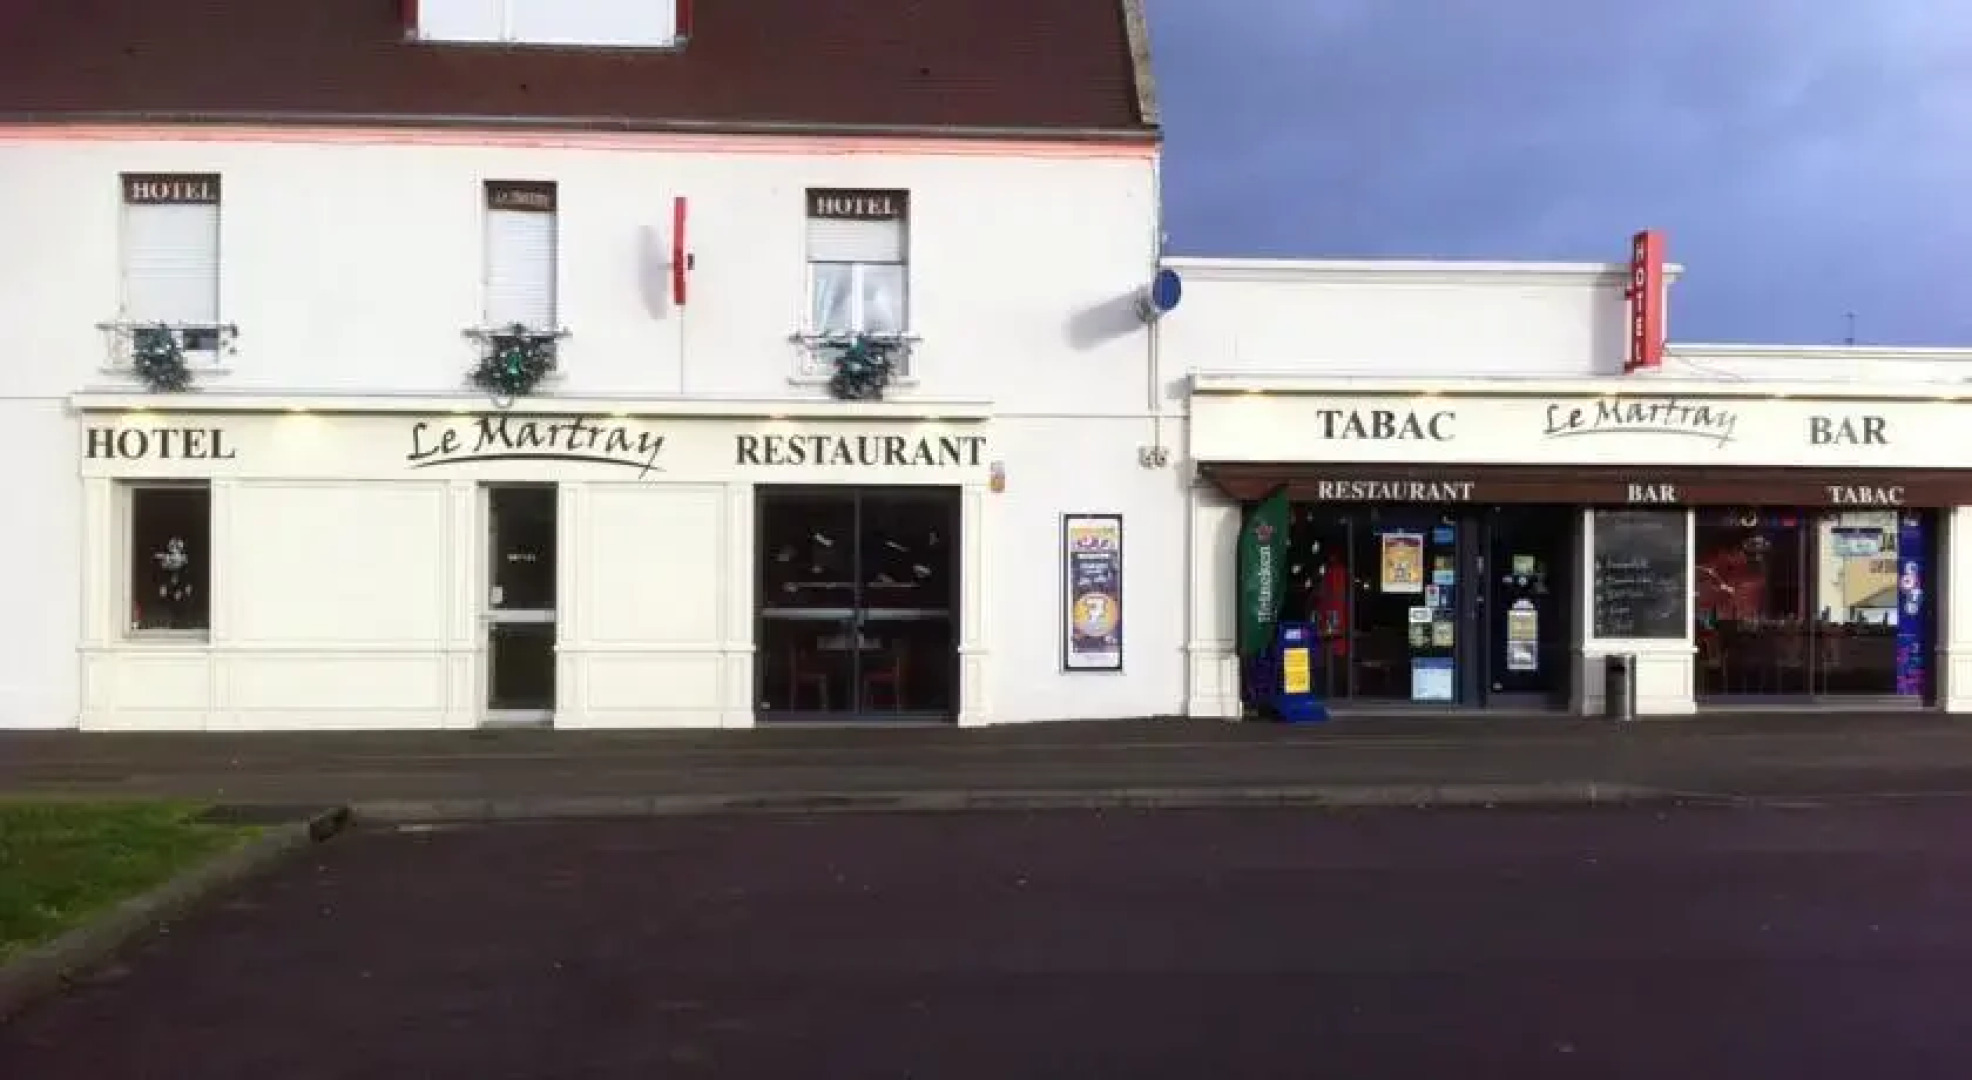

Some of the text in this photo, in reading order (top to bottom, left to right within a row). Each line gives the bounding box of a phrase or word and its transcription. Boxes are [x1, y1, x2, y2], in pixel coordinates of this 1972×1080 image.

[132, 181, 214, 200] HOTEL
[815, 195, 898, 215] HOTEL
[1634, 239, 1645, 361] HOTEL
[1316, 410, 1457, 441] TABAC
[1543, 398, 1739, 448] Le Martray
[1808, 415, 1888, 446] BAR
[86, 428, 236, 459] HOTEL
[408, 412, 665, 477] Le Martray
[735, 434, 987, 466] RESTAURANT
[1318, 481, 1475, 501] RESTAURANT
[1627, 484, 1676, 503] BAR
[1828, 485, 1905, 505] TABAC
